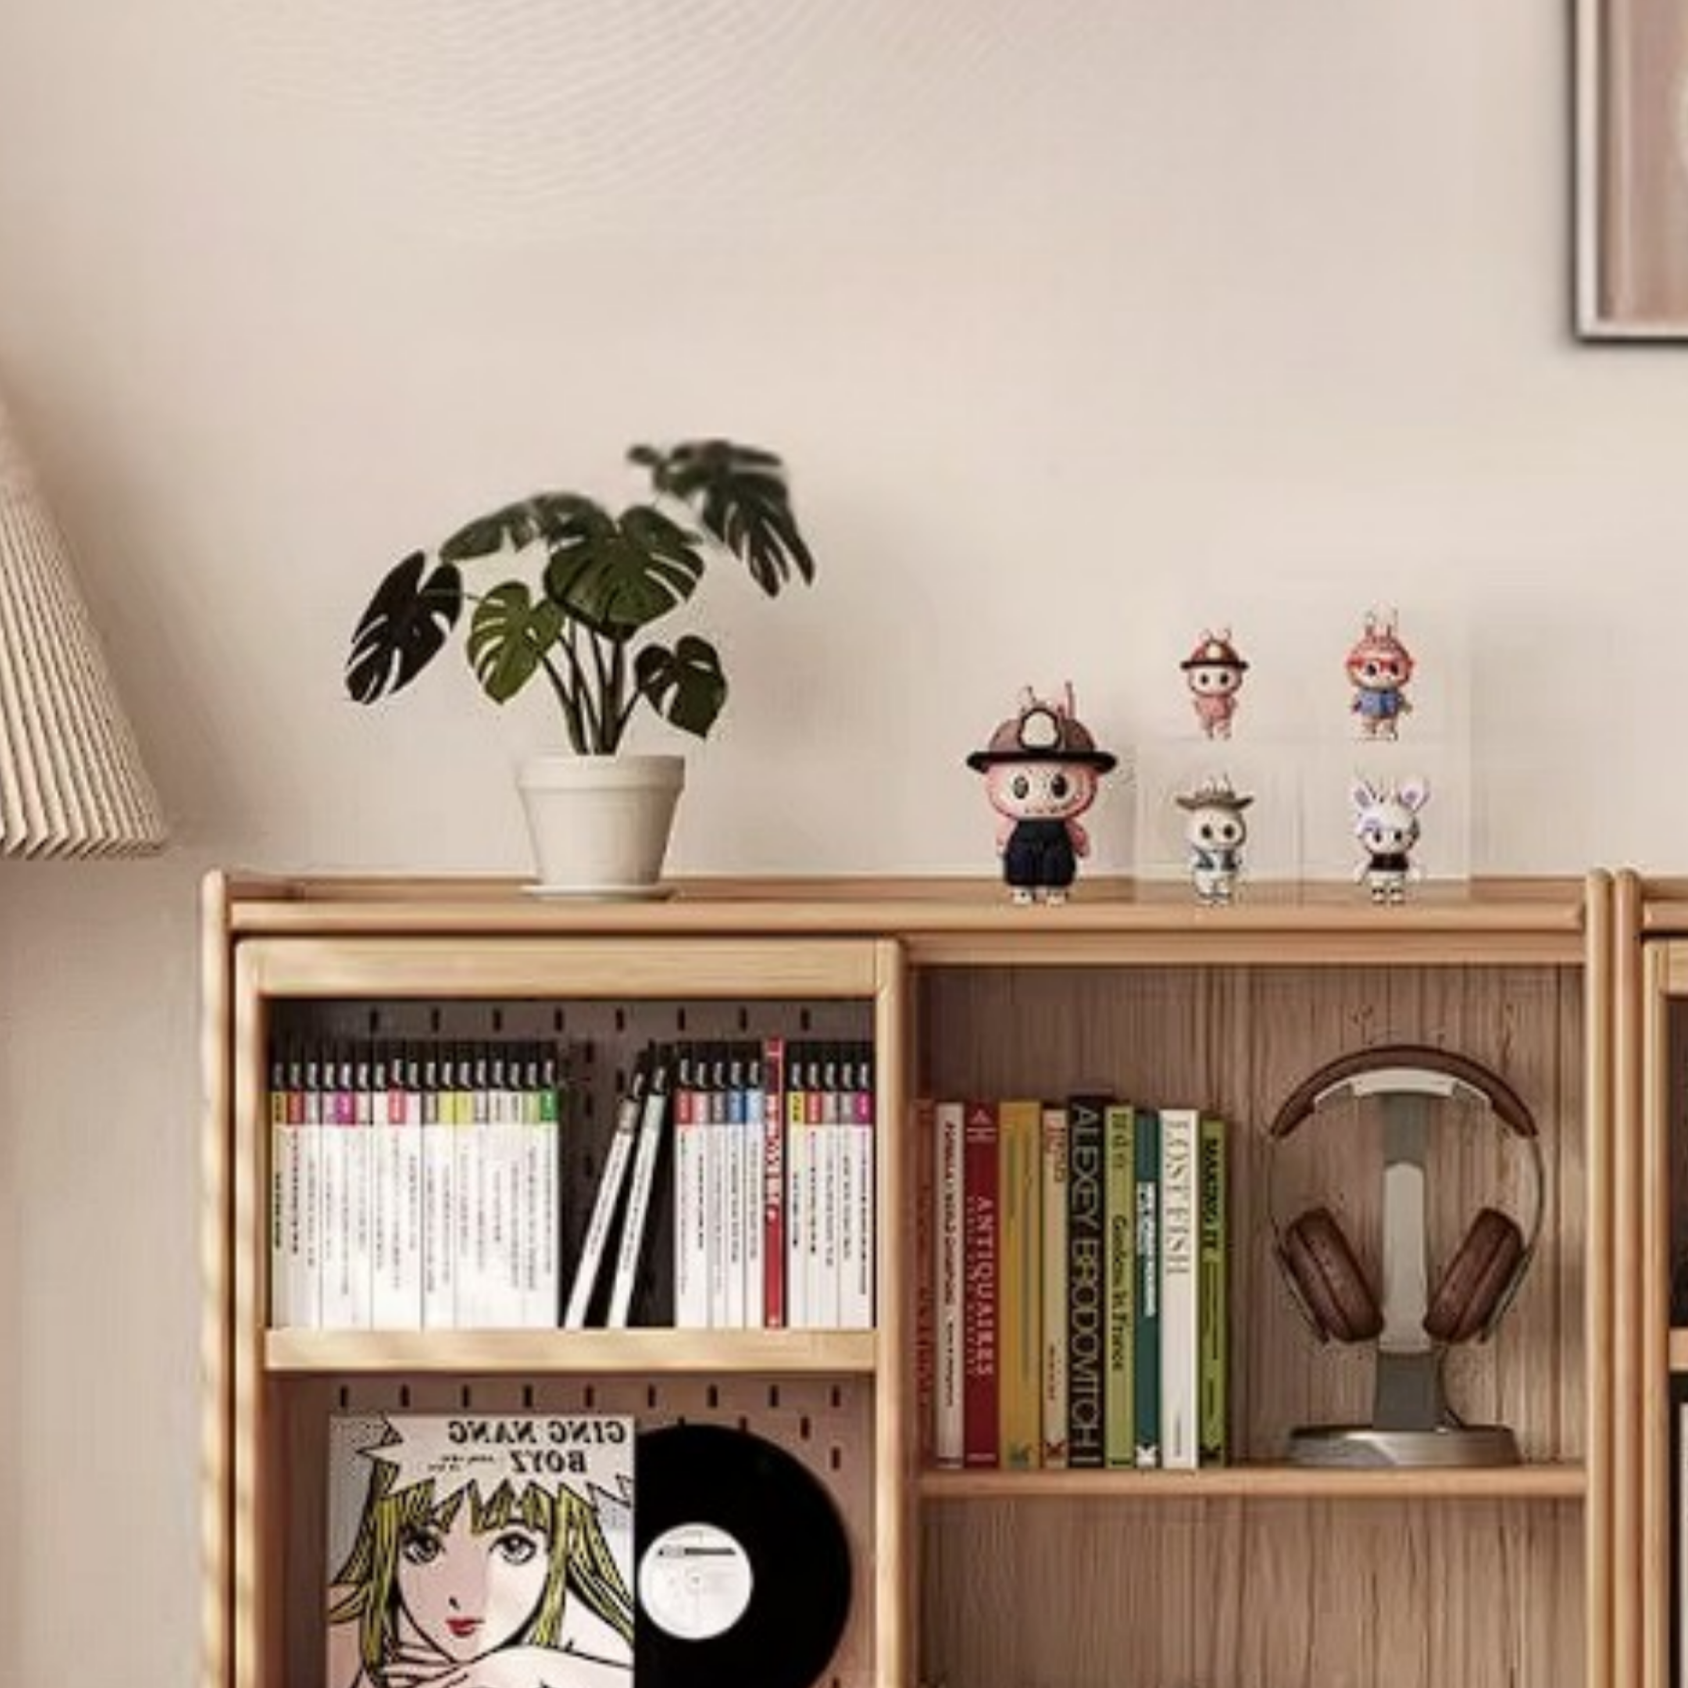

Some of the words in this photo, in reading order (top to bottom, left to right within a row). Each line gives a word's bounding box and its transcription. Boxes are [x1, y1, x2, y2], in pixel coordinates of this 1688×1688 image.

[1072, 1104, 1099, 1231] ALEXEY
[1165, 1119, 1189, 1194] LOST
[1165, 1207, 1189, 1275] FISH
[1072, 1238, 1099, 1447] BRODOVITCH
[1111, 1312, 1127, 1371] France
